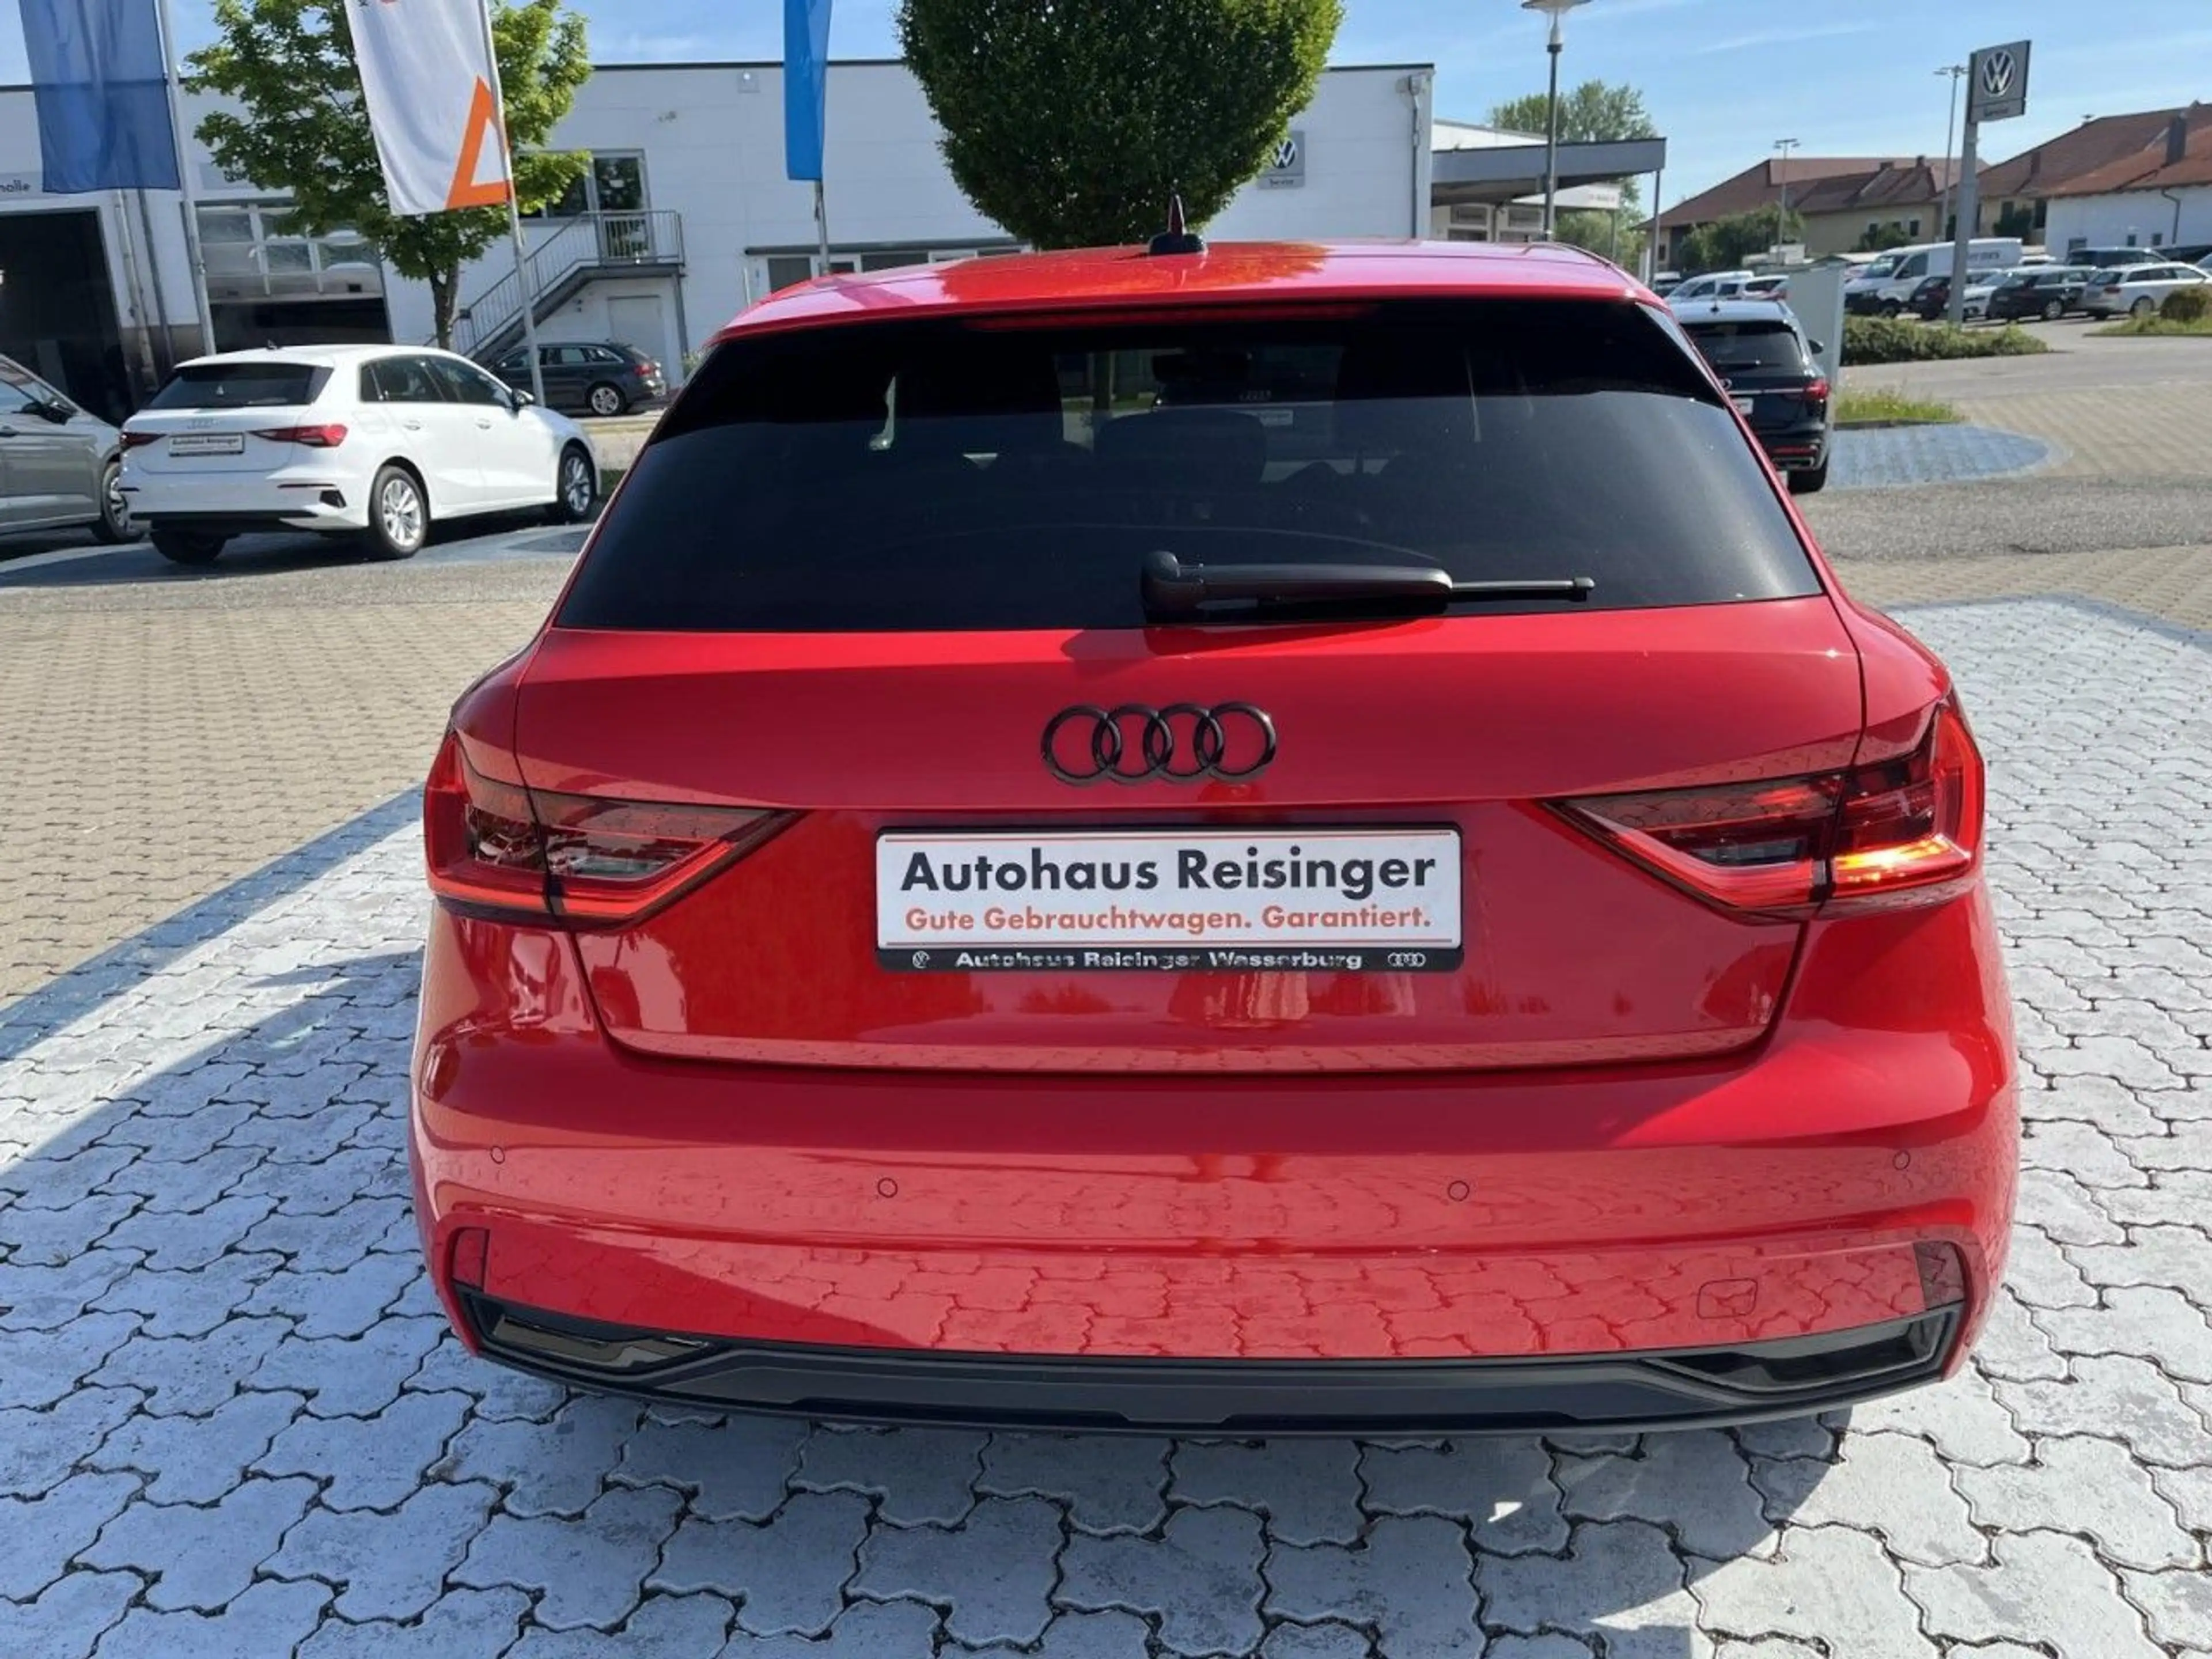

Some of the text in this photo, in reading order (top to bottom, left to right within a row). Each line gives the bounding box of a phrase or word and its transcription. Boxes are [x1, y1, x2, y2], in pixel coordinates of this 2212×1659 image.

[900, 845, 1435, 900] Autohaus Reisinger
[905, 903, 1431, 935] Gute Gebrauchtwagen. Garantiert.
